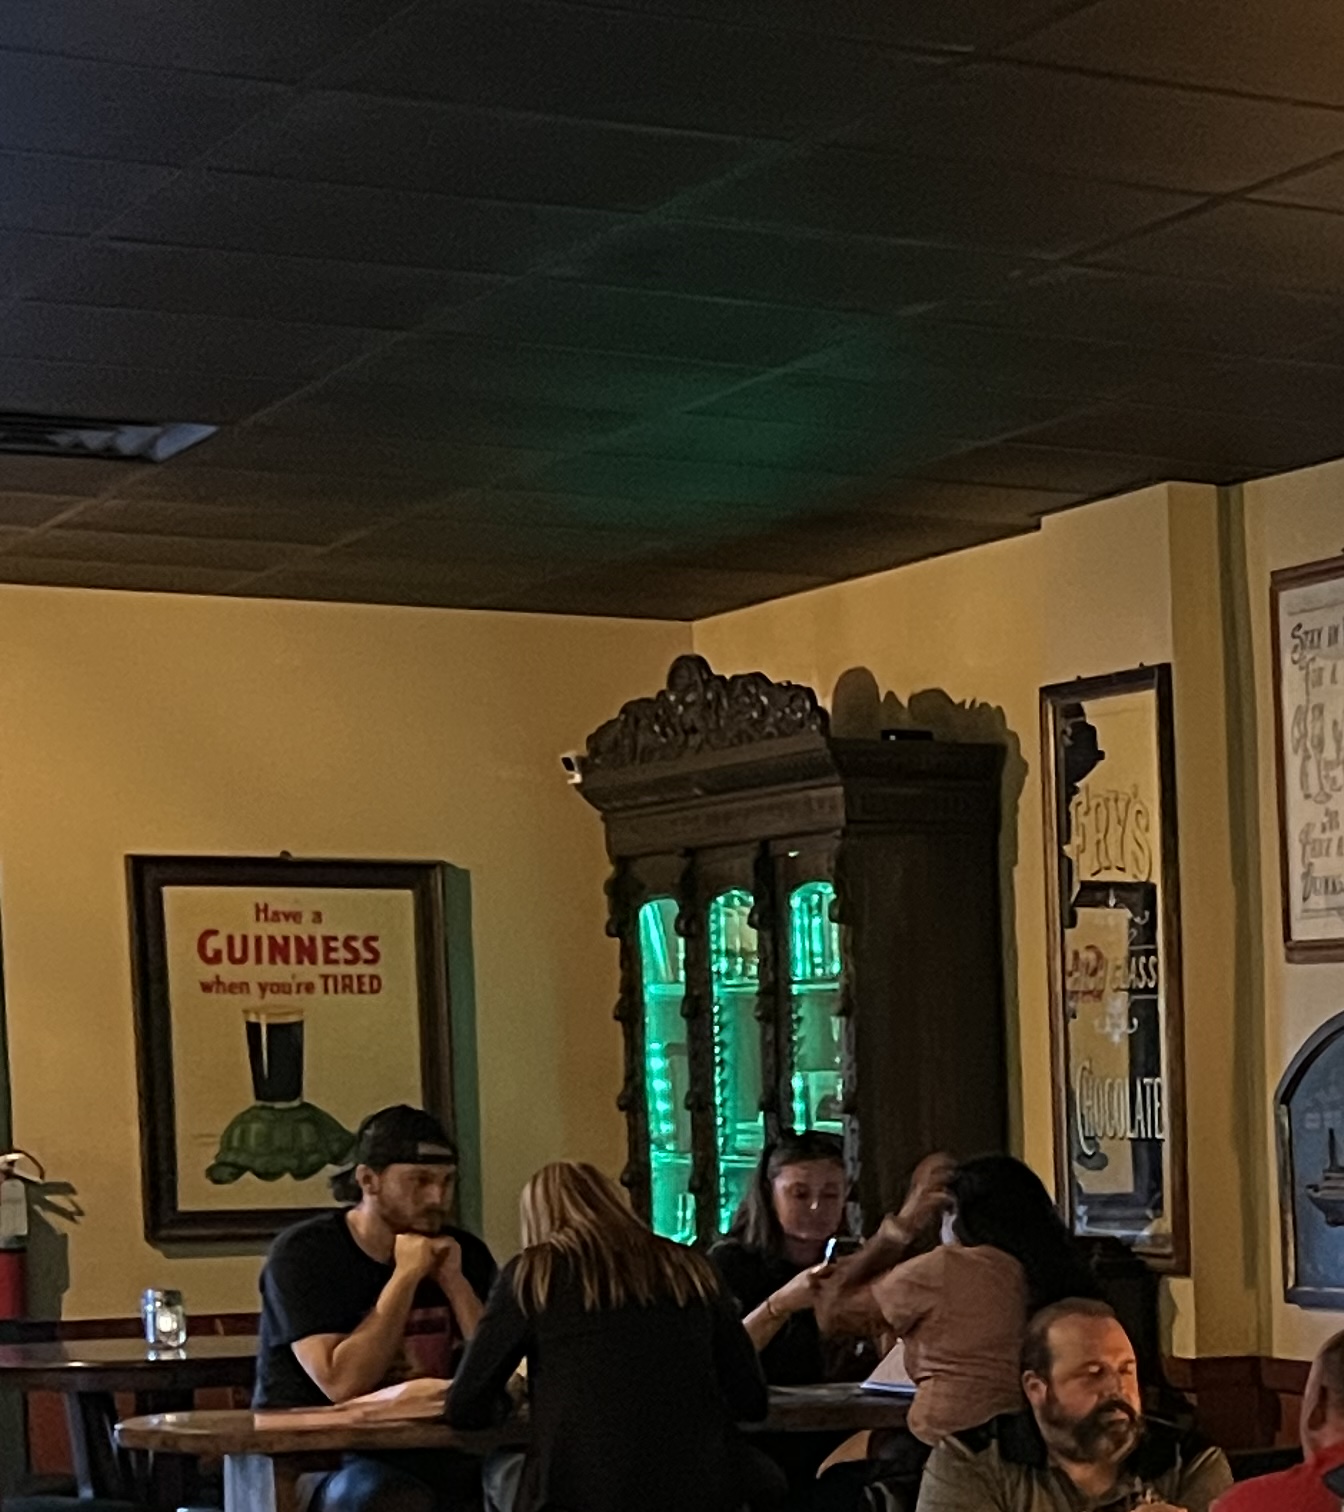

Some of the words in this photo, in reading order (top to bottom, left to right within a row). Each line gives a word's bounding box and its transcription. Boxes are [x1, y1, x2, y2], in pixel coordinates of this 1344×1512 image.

[255, 902, 303, 925] Have
[311, 910, 323, 925] a
[197, 929, 381, 966] GUINNESS
[199, 974, 250, 995] when
[257, 974, 315, 999] you're
[319, 974, 382, 995] TIRED
